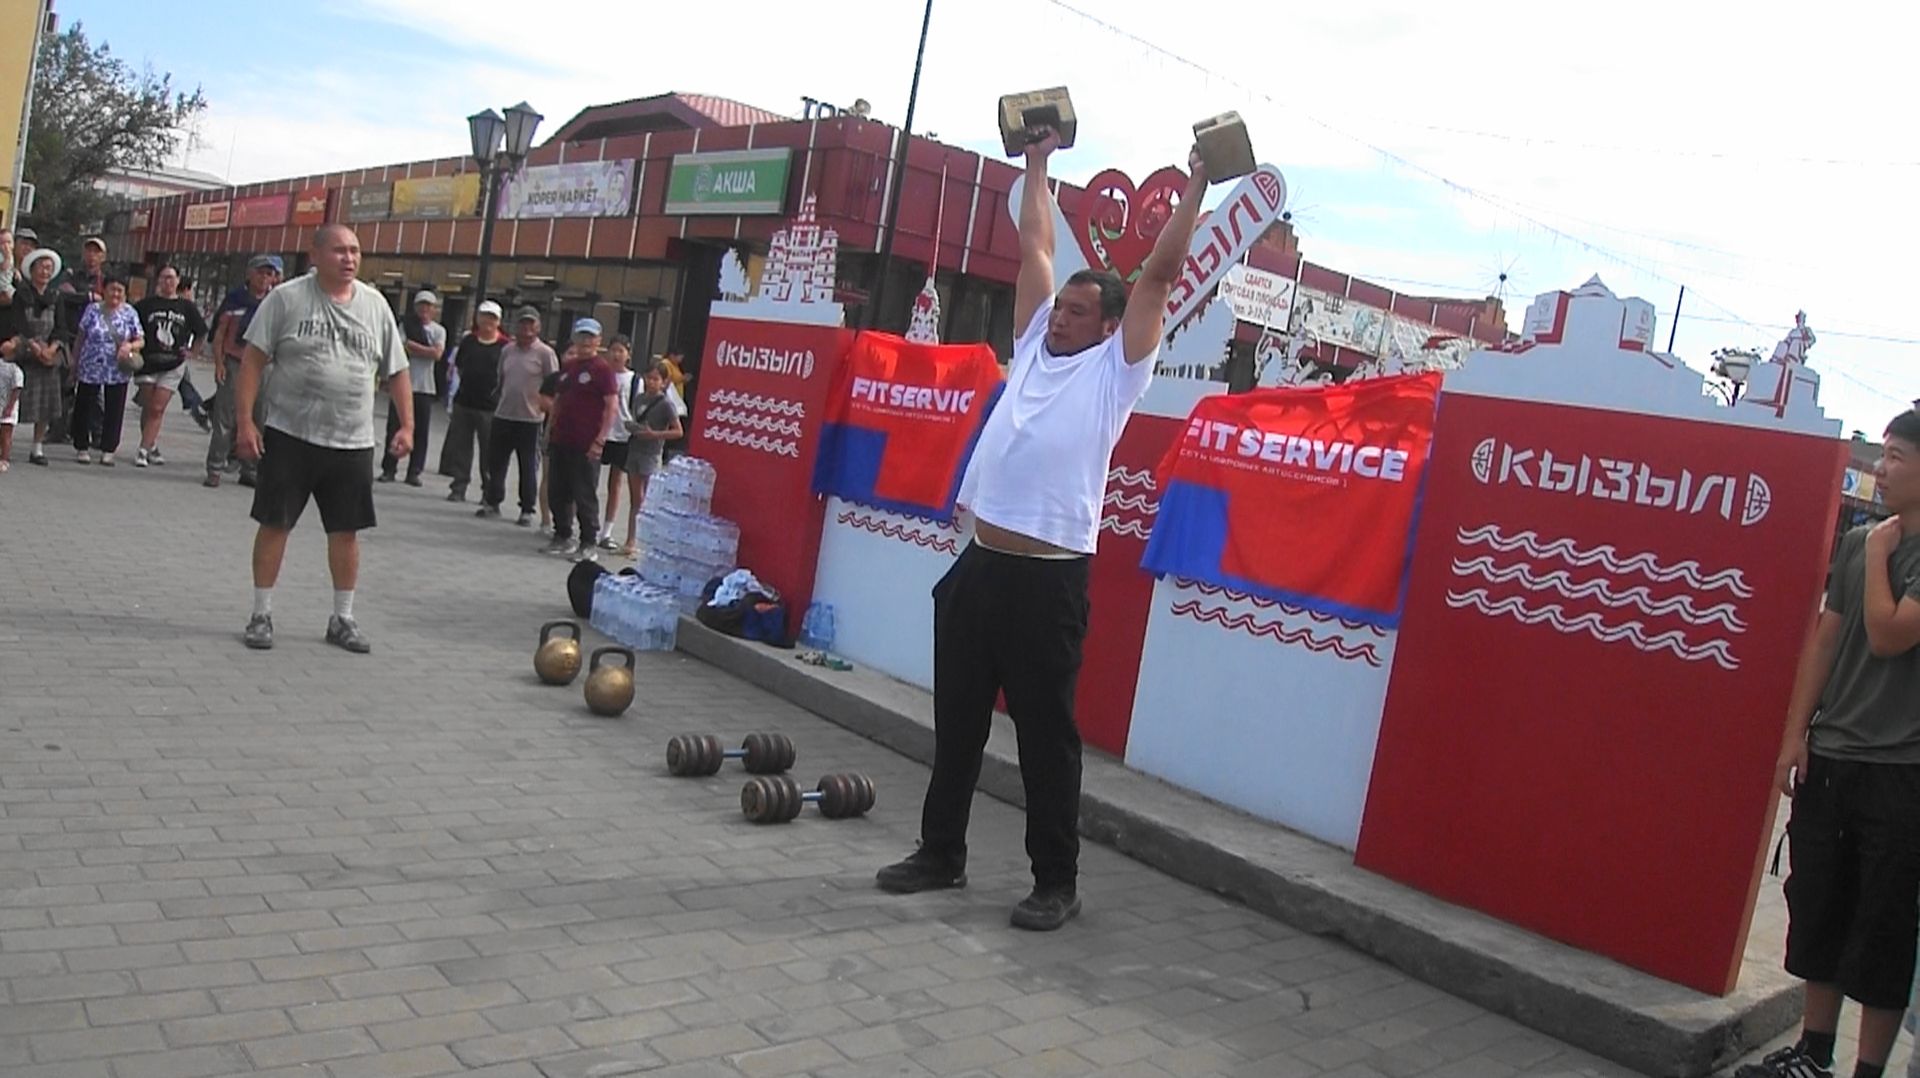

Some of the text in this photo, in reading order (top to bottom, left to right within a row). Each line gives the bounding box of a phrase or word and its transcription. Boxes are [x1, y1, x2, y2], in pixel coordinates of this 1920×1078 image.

[713, 170, 756, 193] АКША
[725, 343, 804, 376] КЫЗЫЛ
[1237, 427, 1409, 482] SERVICE
[1499, 442, 1737, 521] КЫЗЫЛ
